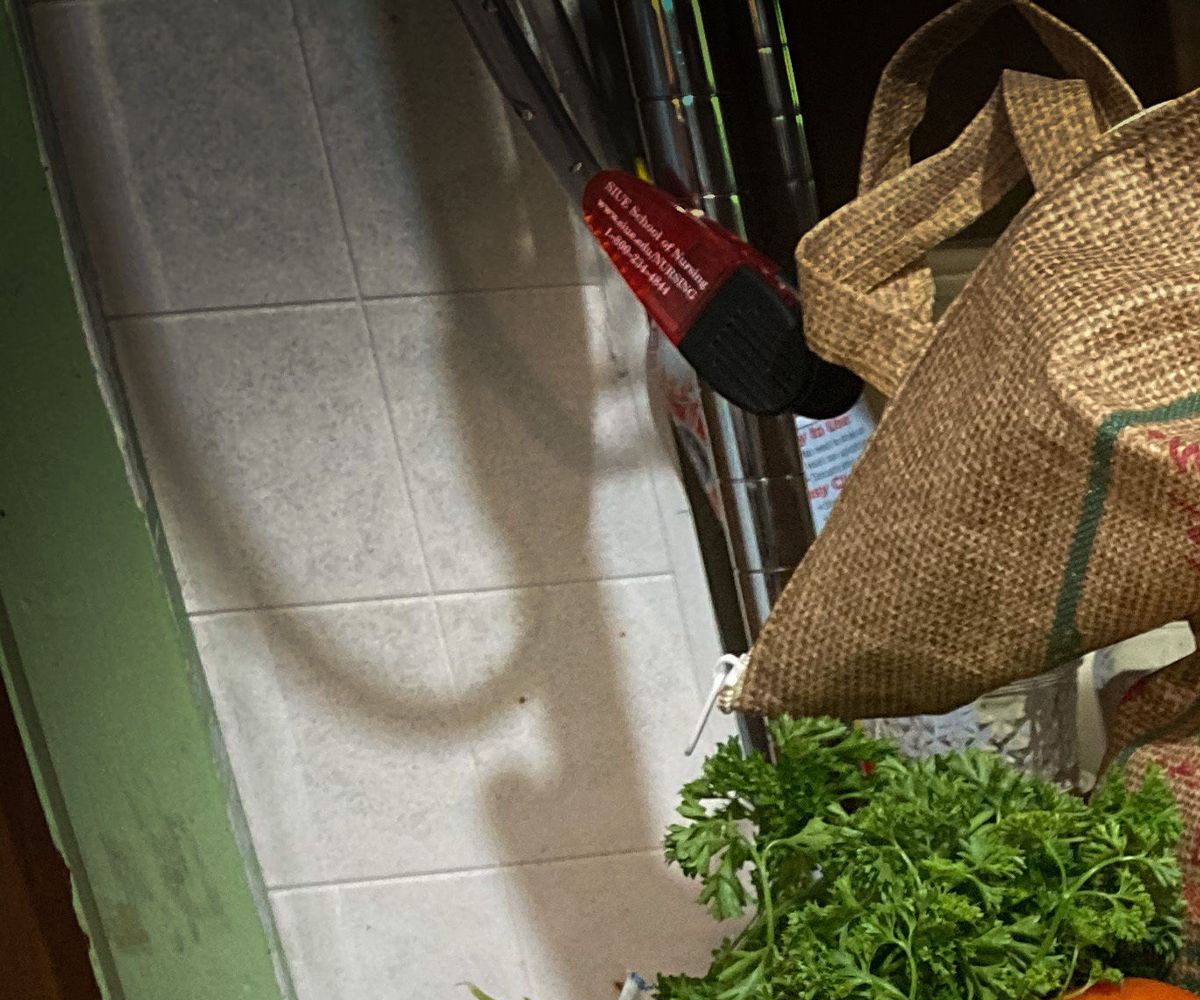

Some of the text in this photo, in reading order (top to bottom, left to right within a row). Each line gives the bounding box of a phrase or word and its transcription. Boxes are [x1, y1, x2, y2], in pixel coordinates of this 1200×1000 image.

[629, 205, 663, 241] School
[661, 240, 675, 252] of
[671, 247, 709, 291] Nursing
